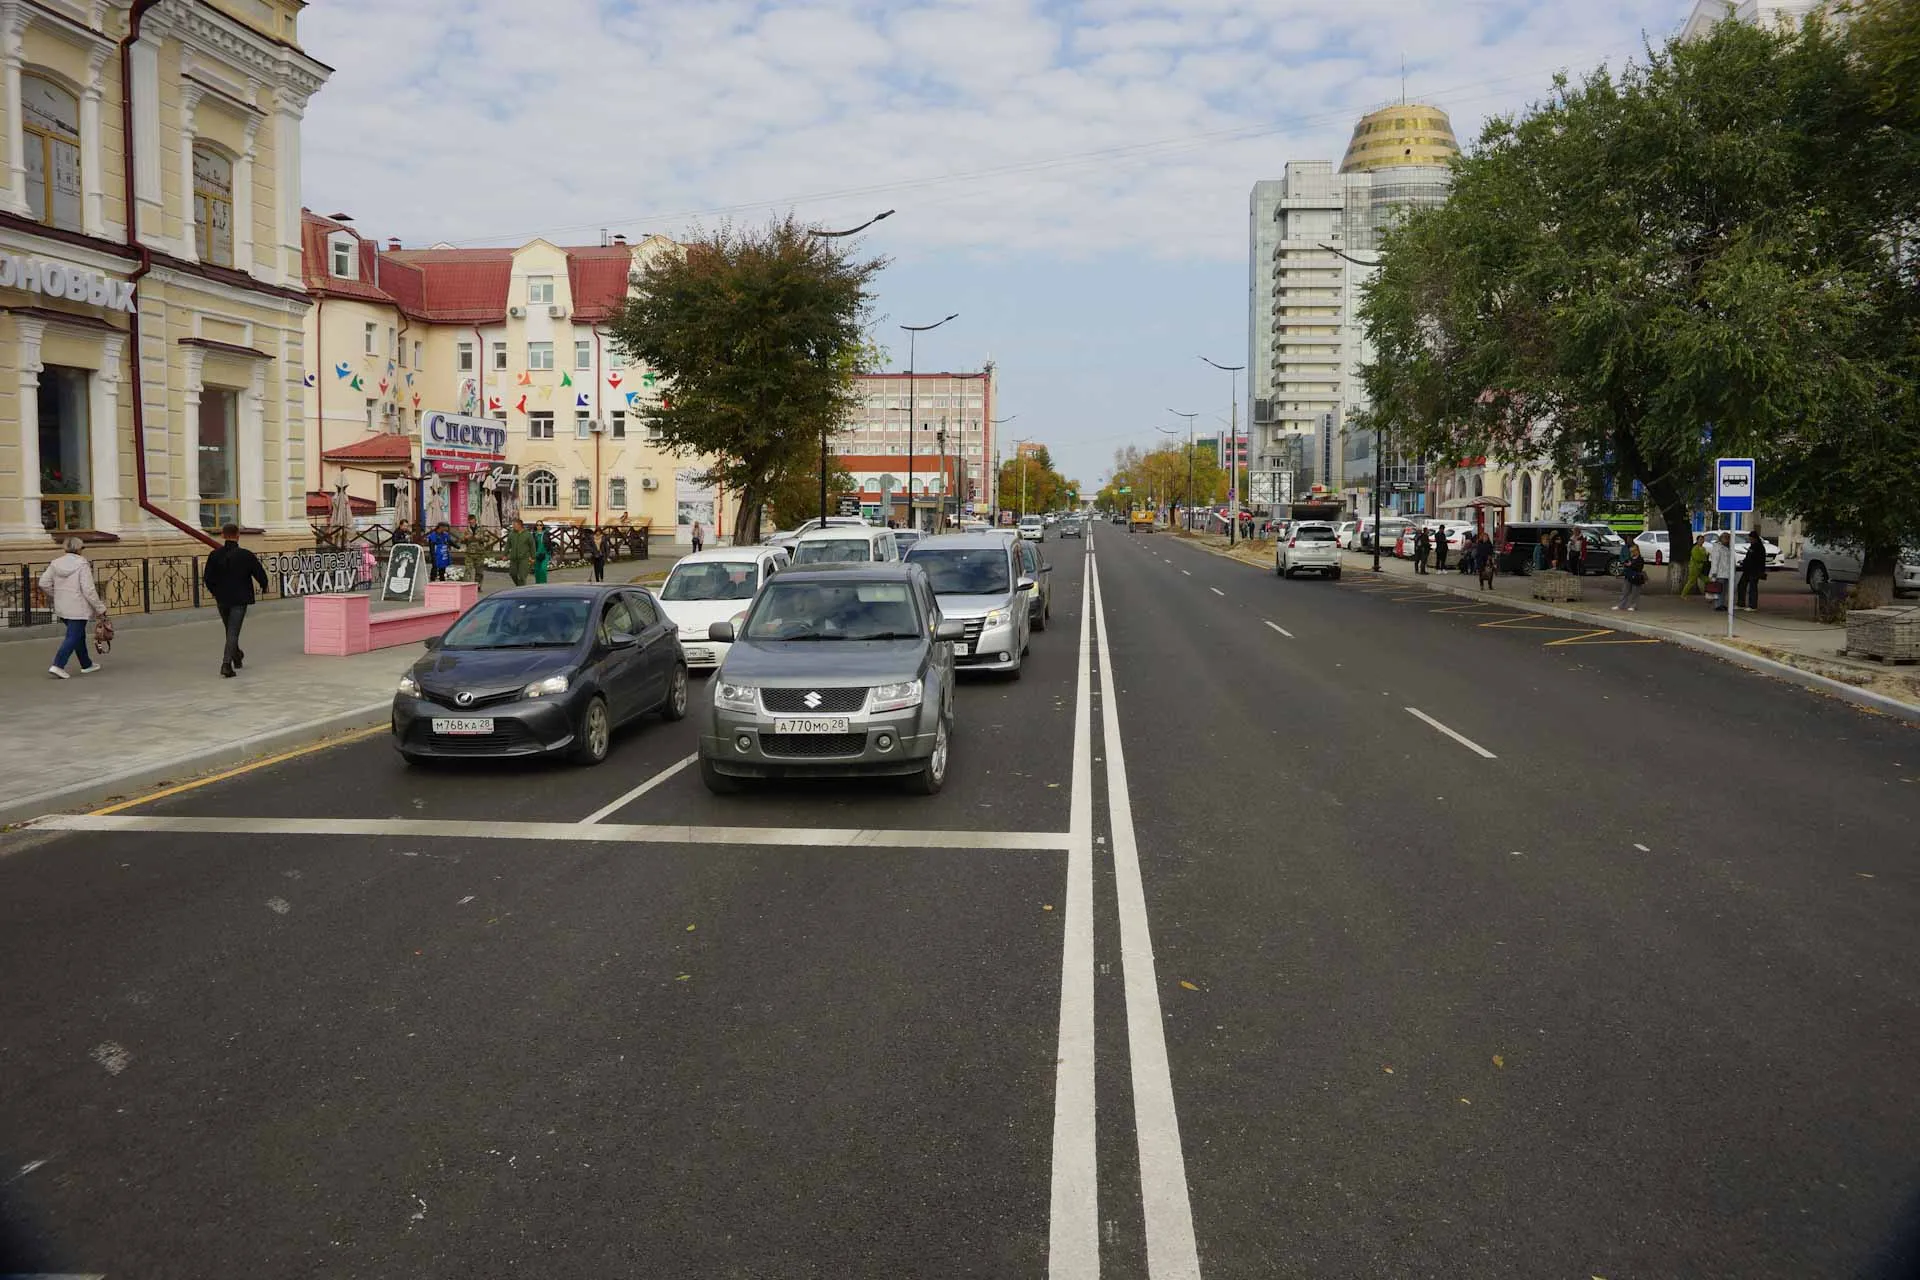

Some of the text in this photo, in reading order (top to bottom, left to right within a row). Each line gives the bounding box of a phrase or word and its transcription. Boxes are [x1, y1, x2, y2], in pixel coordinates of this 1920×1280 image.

[431, 415, 506, 453] Спектр
[283, 569, 357, 596] КАКАДУ
[436, 719, 490, 730] М768КА 28
[780, 719, 844, 732] А770МО 28
